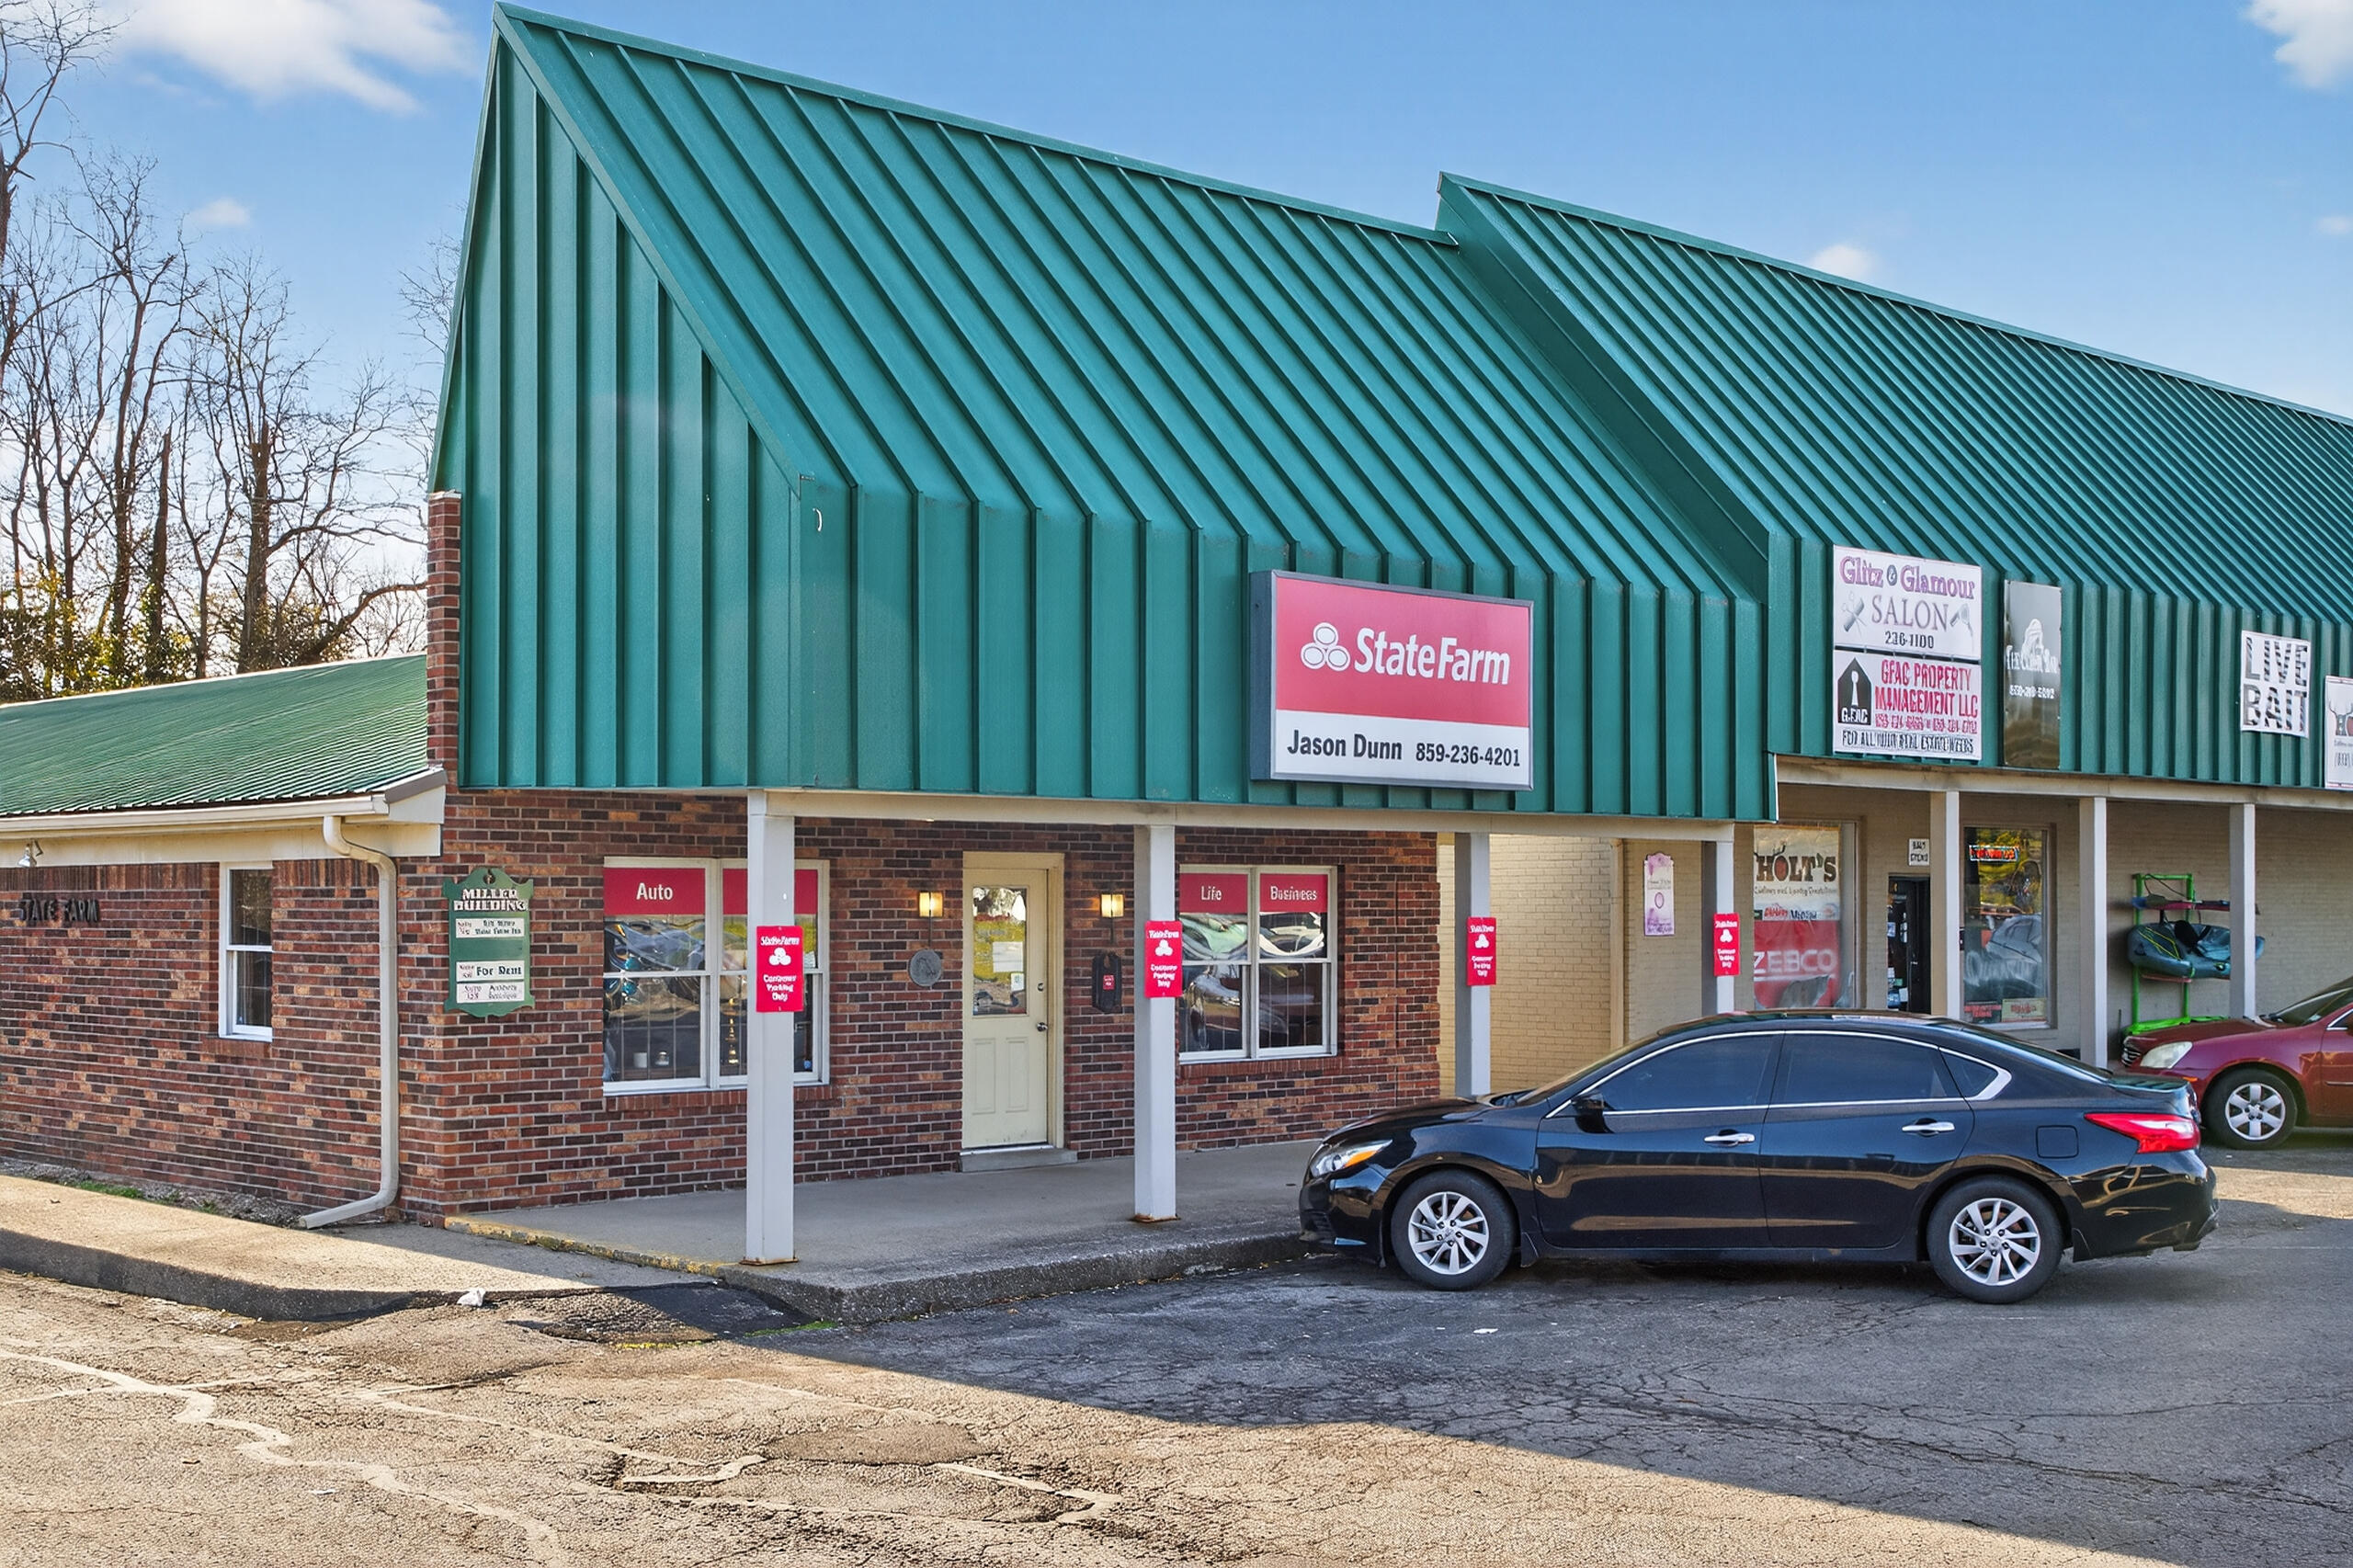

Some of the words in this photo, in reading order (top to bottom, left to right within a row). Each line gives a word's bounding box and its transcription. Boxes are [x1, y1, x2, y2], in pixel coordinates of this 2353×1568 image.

[1839, 555, 1883, 588] Glitz
[1900, 564, 1975, 600] Glamour
[1871, 595, 1949, 632] SALON
[2245, 636, 2308, 687] LIVE
[1914, 663, 1972, 691] PROPERTY
[1875, 686, 1955, 716] MANAGEMENT
[1959, 694, 1979, 719] LLC
[2243, 683, 2308, 733] BAIT
[1287, 729, 1347, 757] Jason
[1353, 733, 1403, 760] Dunn
[1415, 742, 1520, 767] 859-236-4201
[1861, 732, 1875, 747] ALL
[1756, 853, 1836, 883] HOLT'S
[462, 888, 518, 900] MILLER
[636, 882, 674, 900] Auto
[1200, 885, 1222, 901] Life
[1270, 885, 1317, 902] Business
[62, 898, 98, 922] FARM
[454, 900, 529, 912] BUILDING
[1754, 949, 1837, 974] ZEBCO
